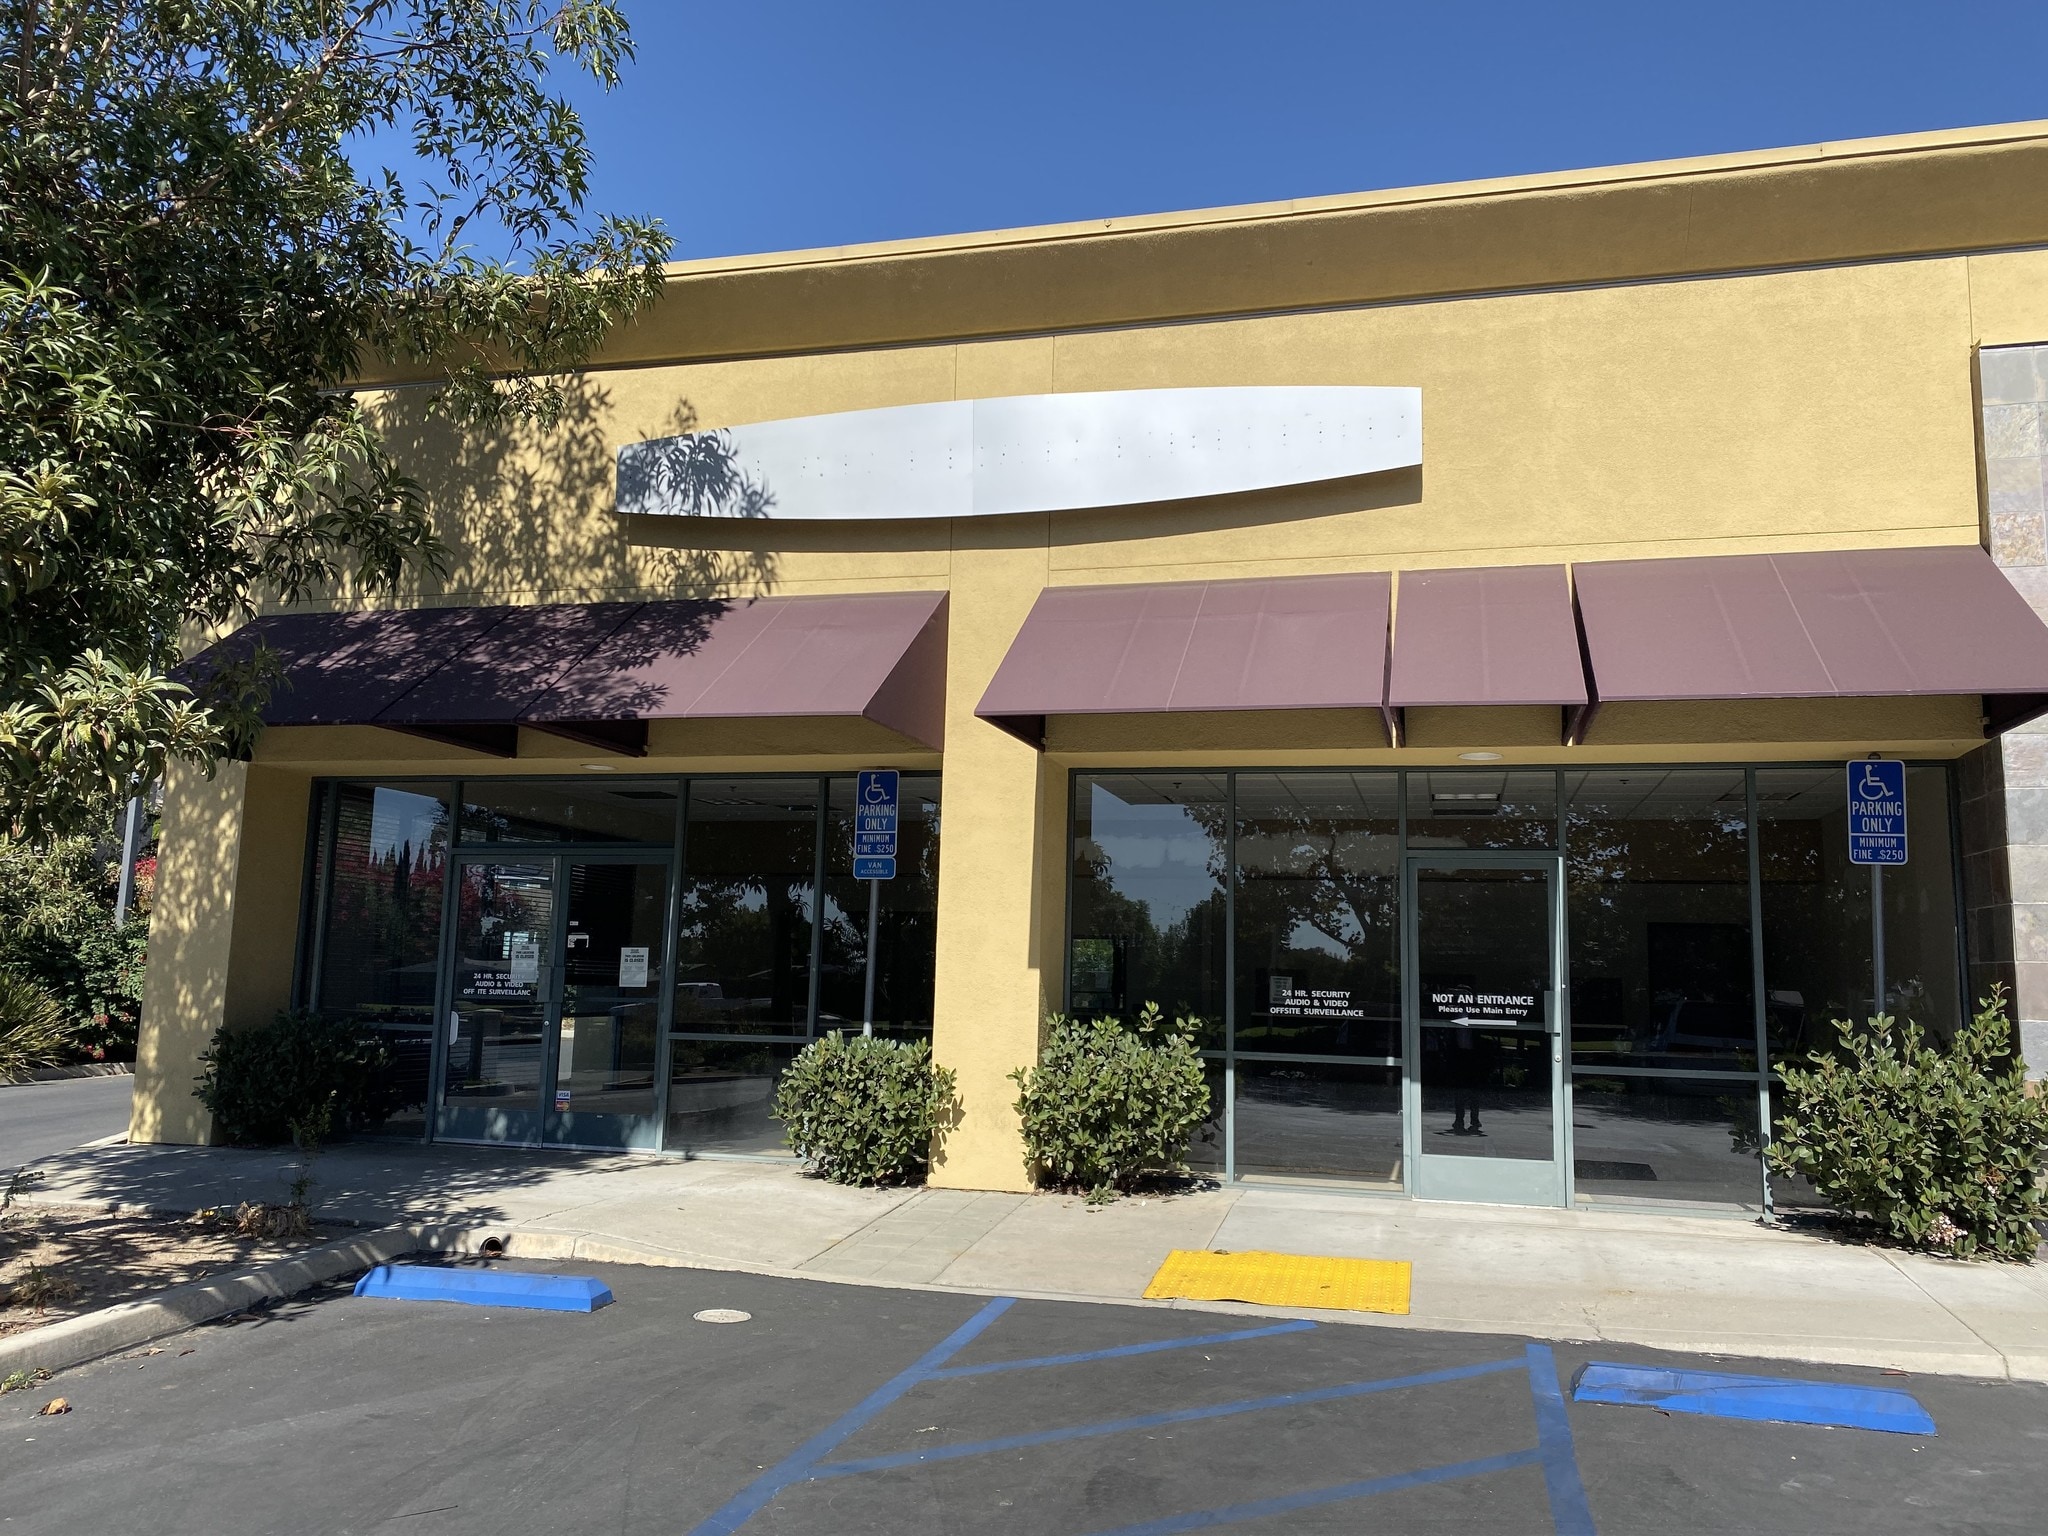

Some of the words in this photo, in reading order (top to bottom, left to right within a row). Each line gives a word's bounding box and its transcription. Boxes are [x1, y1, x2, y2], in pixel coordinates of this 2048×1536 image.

[859, 804, 895, 817] PARKING
[1852, 801, 1902, 816] PARKING
[865, 818, 888, 830] ONLY
[1861, 817, 1893, 833] ONLY
[862, 834, 890, 843] MINIMUM
[1859, 837, 1897, 848] MINIMUM
[857, 844, 871, 853] FINE
[876, 844, 894, 853] $250
[1853, 849, 1873, 860] FINE
[1879, 849, 1904, 860] $250
[868, 861, 882, 869] VAN
[1311, 990, 1351, 998] SECURITY
[1432, 993, 1454, 1003] NOT
[1457, 994, 1473, 1004] AN
[1477, 995, 1534, 1006] ENTRANCE
[1323, 999, 1349, 1007] VIDEO
[1303, 1007, 1364, 1017] SURVEILLANCE
[1438, 1005, 1463, 1013] Please
[1505, 1008, 1528, 1017] Entry
